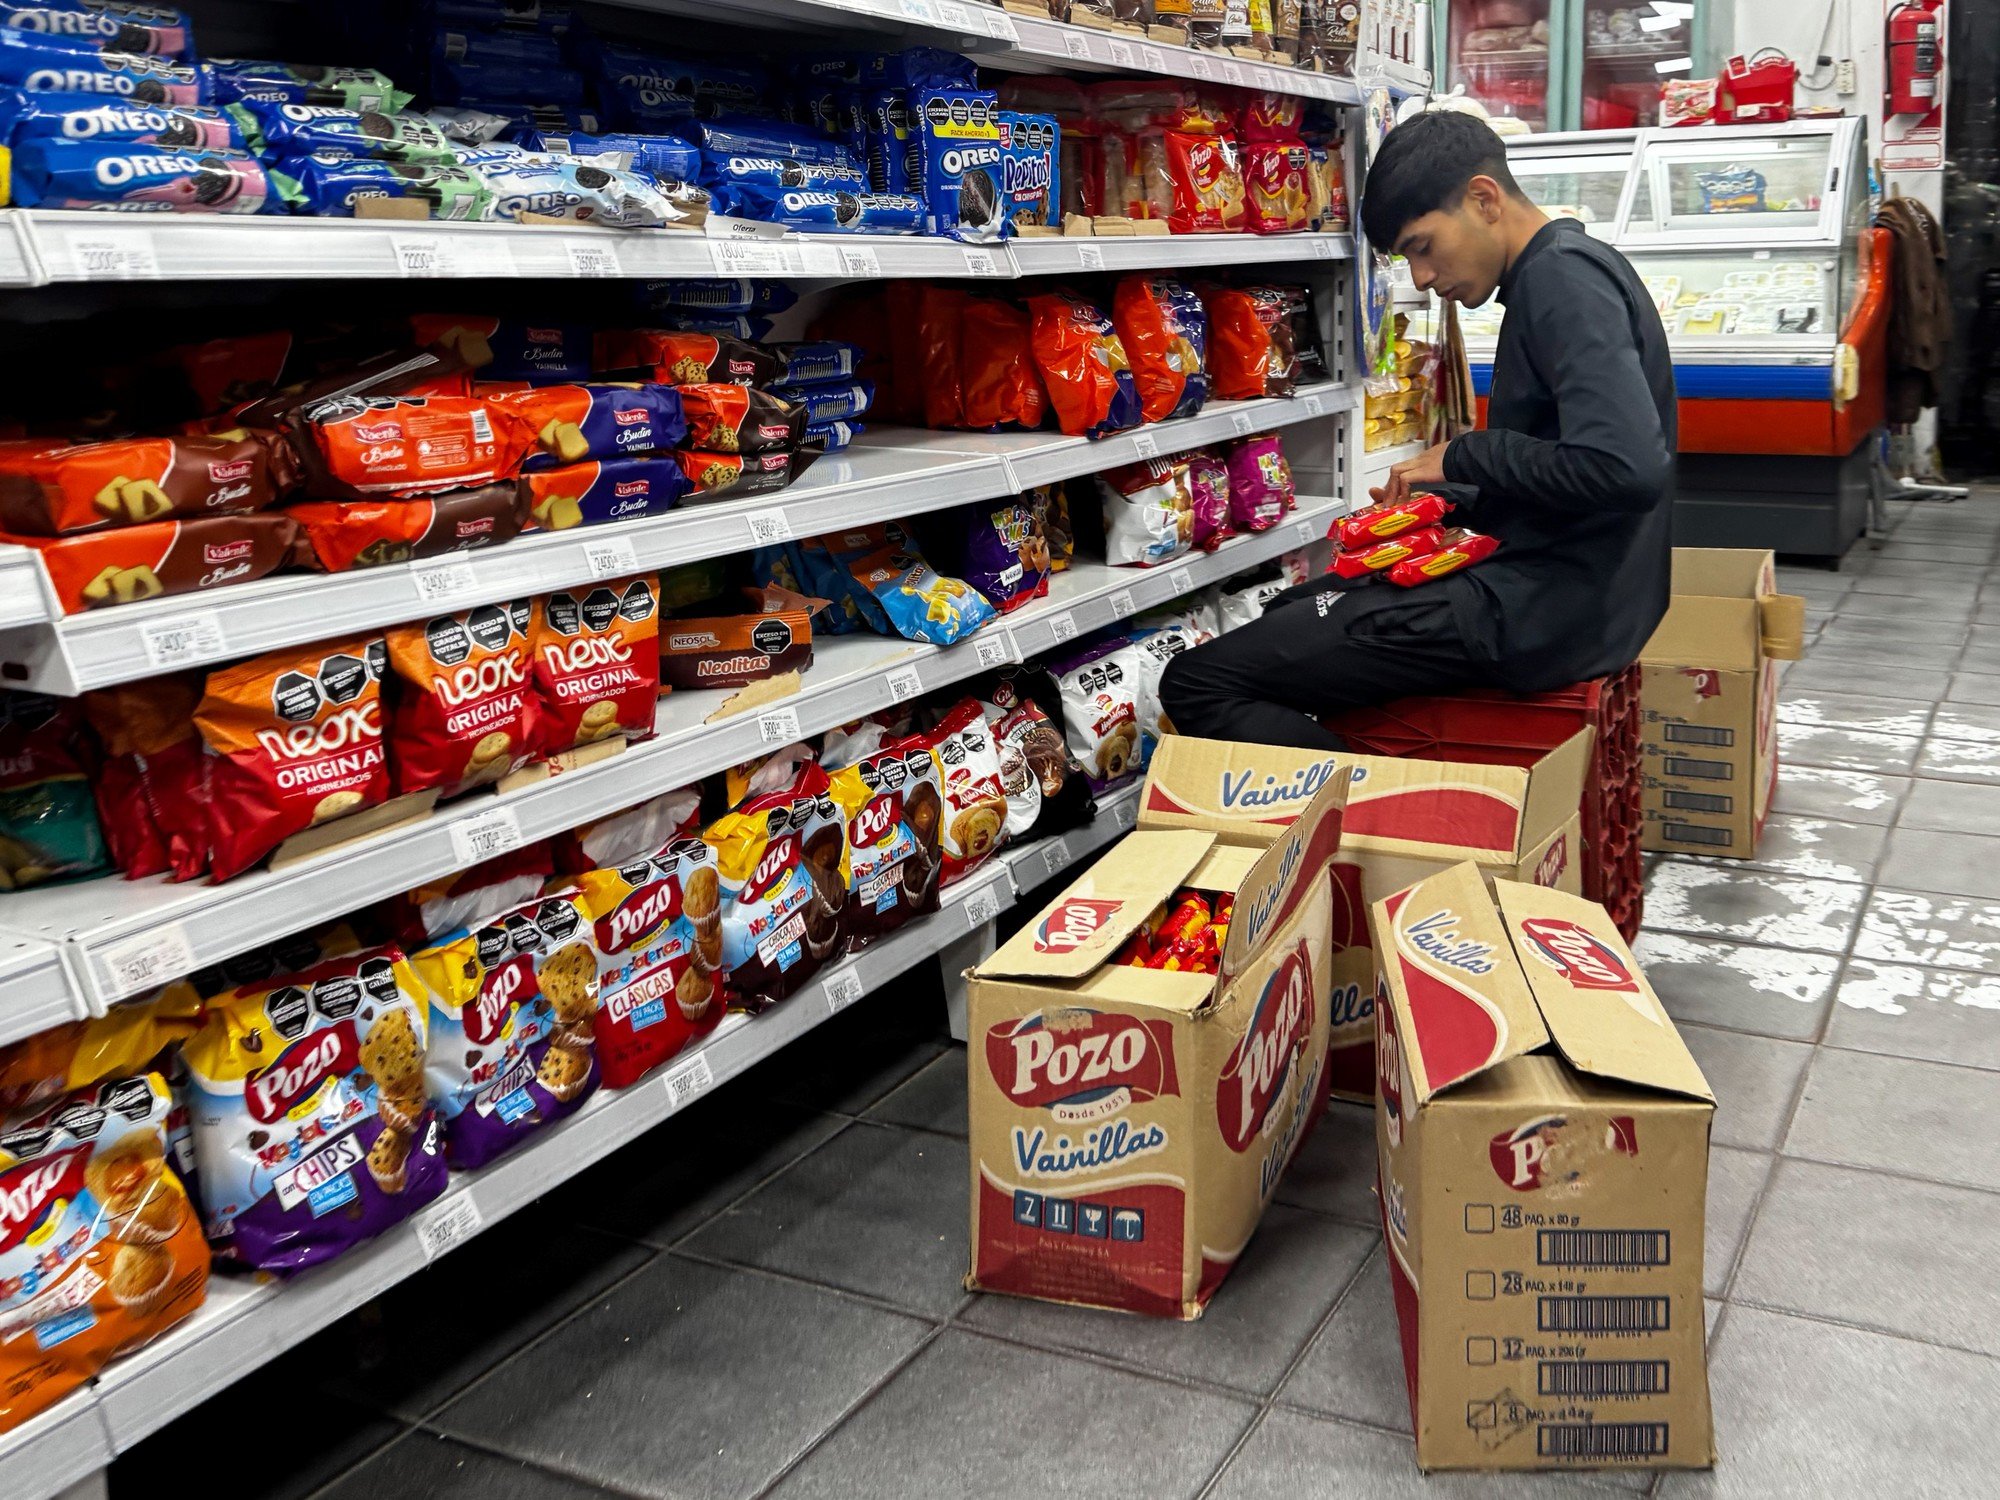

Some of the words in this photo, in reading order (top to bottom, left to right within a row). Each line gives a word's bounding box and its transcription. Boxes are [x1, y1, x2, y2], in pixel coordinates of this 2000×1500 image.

[8, 10, 118, 37] OREO
[811, 60, 845, 74] OREO
[25, 70, 136, 95] OREO
[62, 106, 168, 138] OREO
[282, 104, 360, 121] OREO
[878, 107, 888, 134] OREO
[96, 155, 199, 185] OREO
[729, 157, 784, 176] OREO
[944, 148, 999, 173] OREO
[1004, 152, 1051, 192] Pepitos!
[497, 193, 582, 217] OREO
[783, 192, 838, 212] OREO
[617, 411, 647, 422] Valente
[626, 442, 655, 451] VAINILLA
[617, 483, 647, 495] Valente
[542, 631, 633, 675] neox
[674, 636, 711, 646] NEOSOL
[433, 648, 525, 708] neox
[698, 655, 770, 677] Neolitas
[556, 668, 641, 698] ORIGINAL
[579, 686, 627, 704] HORNEADOS
[609, 884, 671, 951] Pozo
[768, 915, 803, 947] CHOCOLATE
[1050, 905, 1098, 948] Pozo
[1406, 911, 1493, 976] Vainillas
[1527, 922, 1623, 982] Pozo
[613, 972, 671, 1018] CLÁSICAS
[1011, 1028, 1147, 1095] Pozo
[1238, 966, 1303, 1142] Pozo
[252, 1032, 342, 1119] Pozo
[489, 1063, 533, 1103] CHIPS
[1059, 1108, 1096, 1120] Desde
[1099, 1095, 1125, 1114] 1951
[1016, 1121, 1164, 1173] Vainillas
[293, 1140, 357, 1194] CHIPS
[1503, 1208, 1521, 1225] 48
[1557, 1215, 1569, 1225] 80
[1503, 1274, 1522, 1292] 28
[1504, 1341, 1522, 1357] 12
